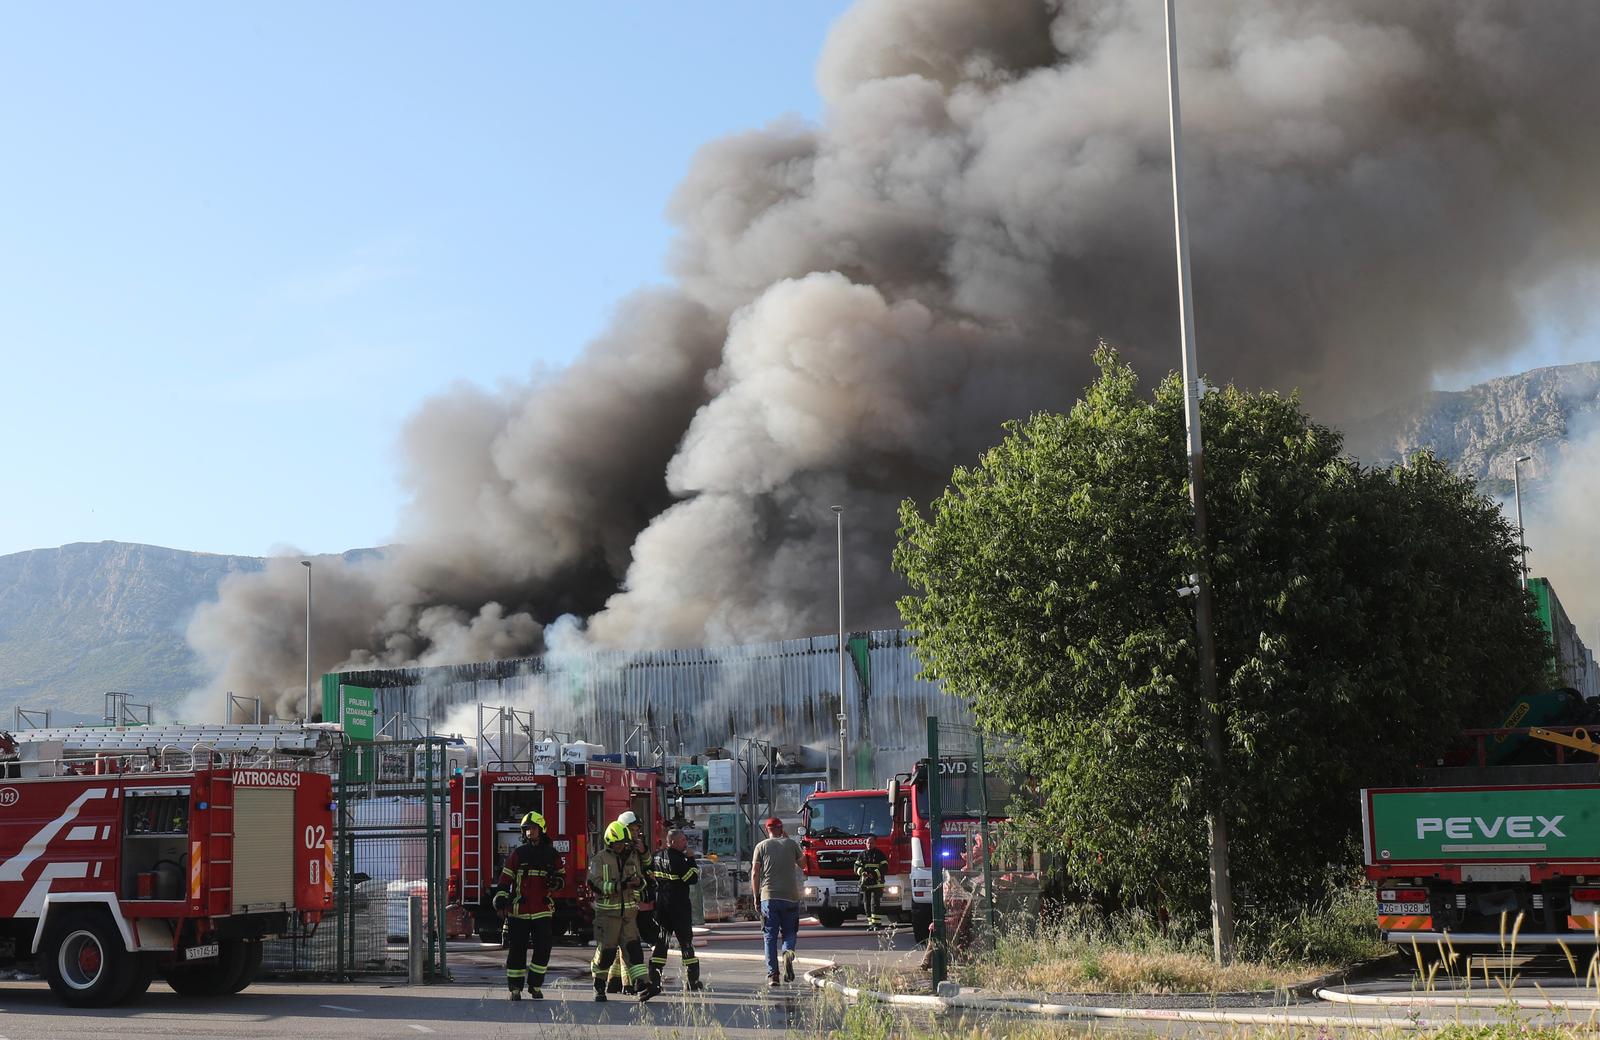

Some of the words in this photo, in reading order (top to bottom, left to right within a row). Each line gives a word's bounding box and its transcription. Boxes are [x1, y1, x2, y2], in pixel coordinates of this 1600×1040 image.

[349, 698, 367, 707] PRIJEM
[345, 708, 373, 717] IZDAVANJE
[352, 718, 366, 726] ROBE
[232, 771, 301, 786] VATROGASCI
[0, 792, 14, 802] 193
[1416, 815, 1566, 840] PEVEX
[305, 825, 325, 849] 02
[1384, 903, 1394, 912] ZG
[1400, 903, 1419, 913] 1928
[1420, 903, 1430, 912] JM
